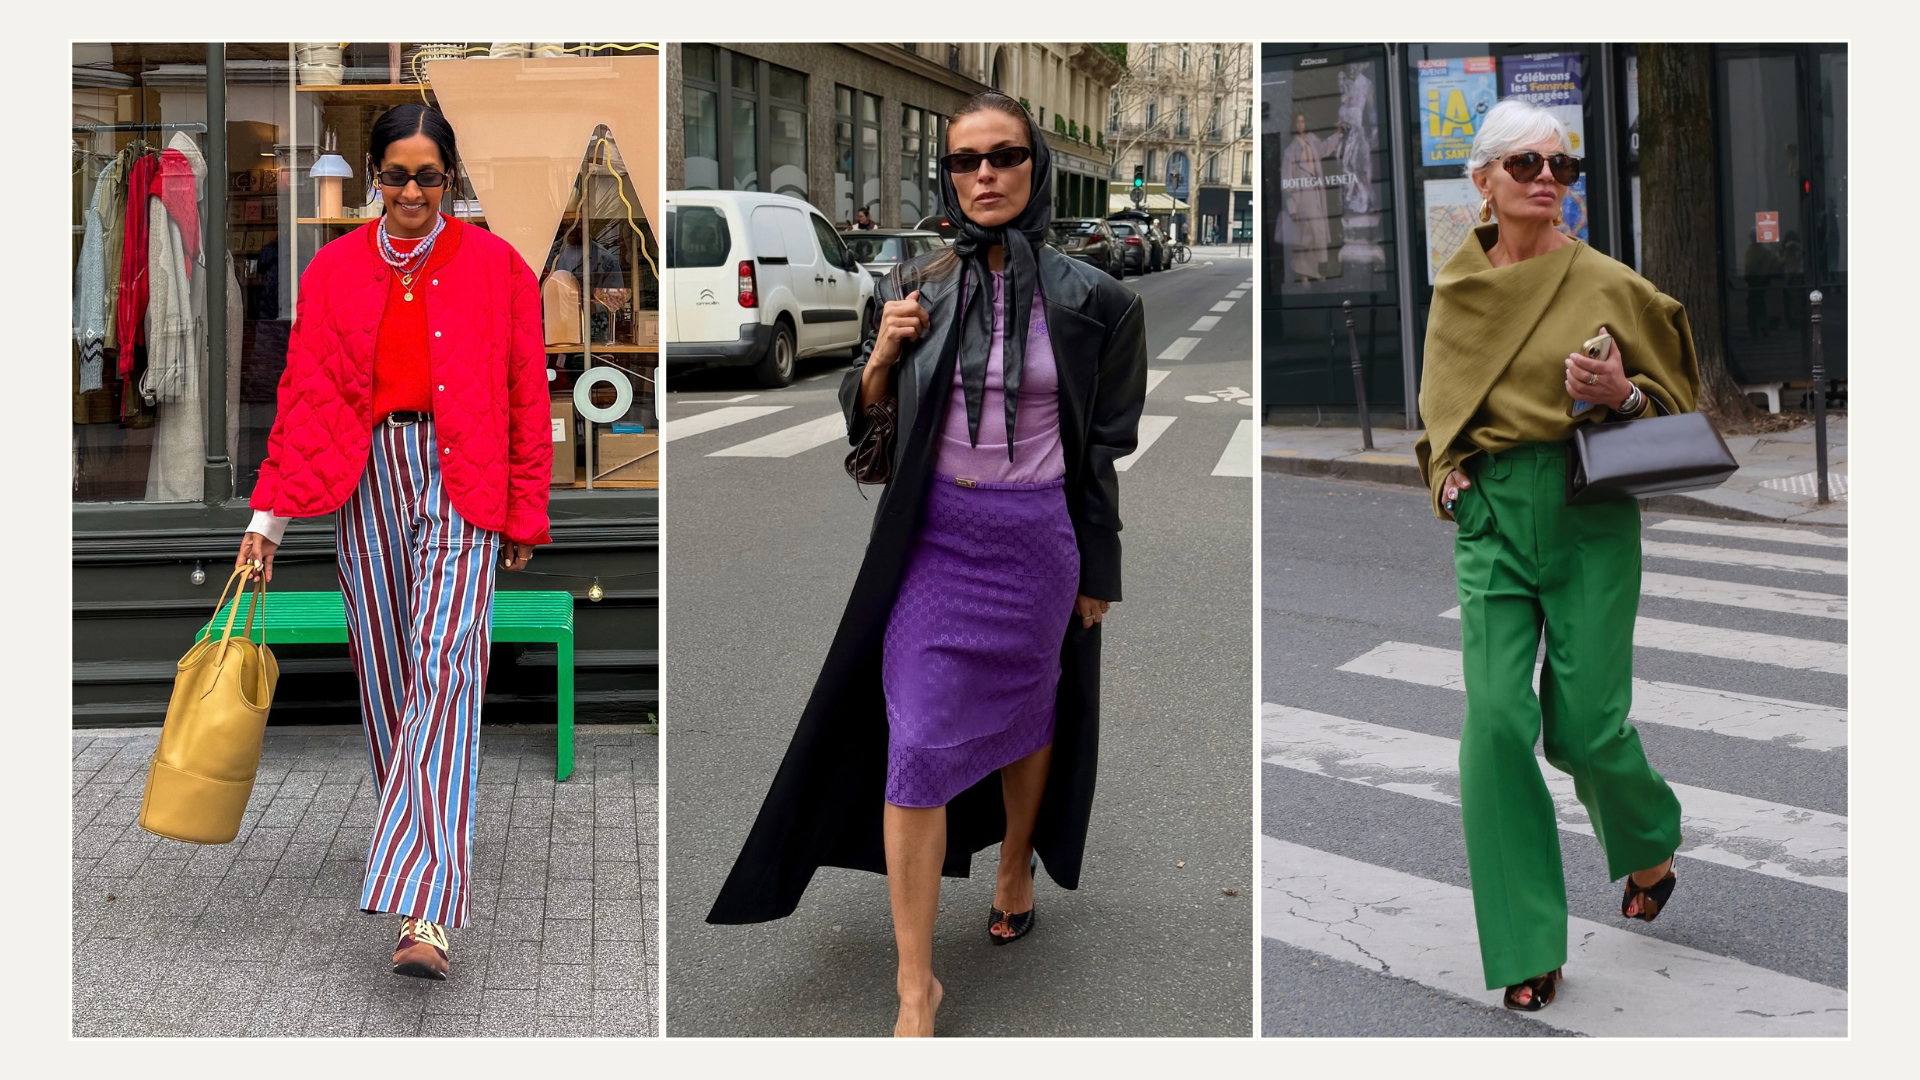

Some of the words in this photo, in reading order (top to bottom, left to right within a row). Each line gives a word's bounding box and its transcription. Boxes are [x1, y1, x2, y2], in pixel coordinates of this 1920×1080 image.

[1421, 68, 1447, 77] AVENIR
[1515, 72, 1570, 82] Célébrons
[1511, 83, 1527, 92] les
[1529, 82, 1575, 91] Femmes
[1517, 90, 1570, 103] engagées
[1431, 151, 1443, 160] LA
[1445, 149, 1471, 160] SANT
[1282, 176, 1323, 189] BOTTEGA
[1325, 174, 1358, 186] VENETA
